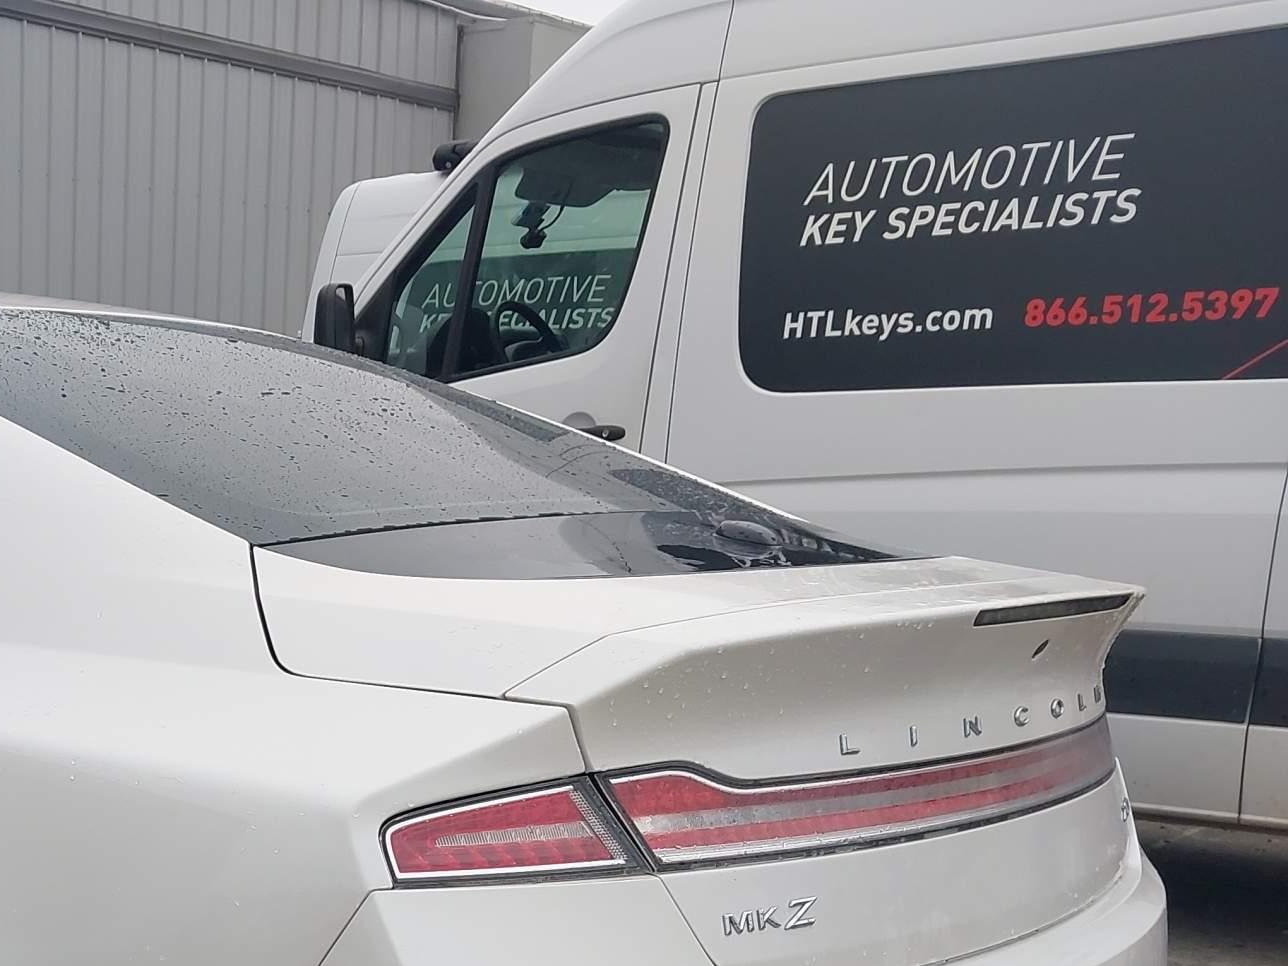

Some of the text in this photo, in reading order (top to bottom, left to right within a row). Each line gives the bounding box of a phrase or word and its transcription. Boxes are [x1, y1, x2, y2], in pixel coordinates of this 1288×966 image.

[803, 132, 1136, 206] AUTOMOTIVE
[799, 188, 1143, 247] KEY SPECIALISTS
[421, 274, 612, 309] AUOMOTIVE
[1024, 287, 1279, 328] 866.512.5397
[782, 307, 993, 342] HTLkeys.com
[722, 896, 818, 936] MKZ
